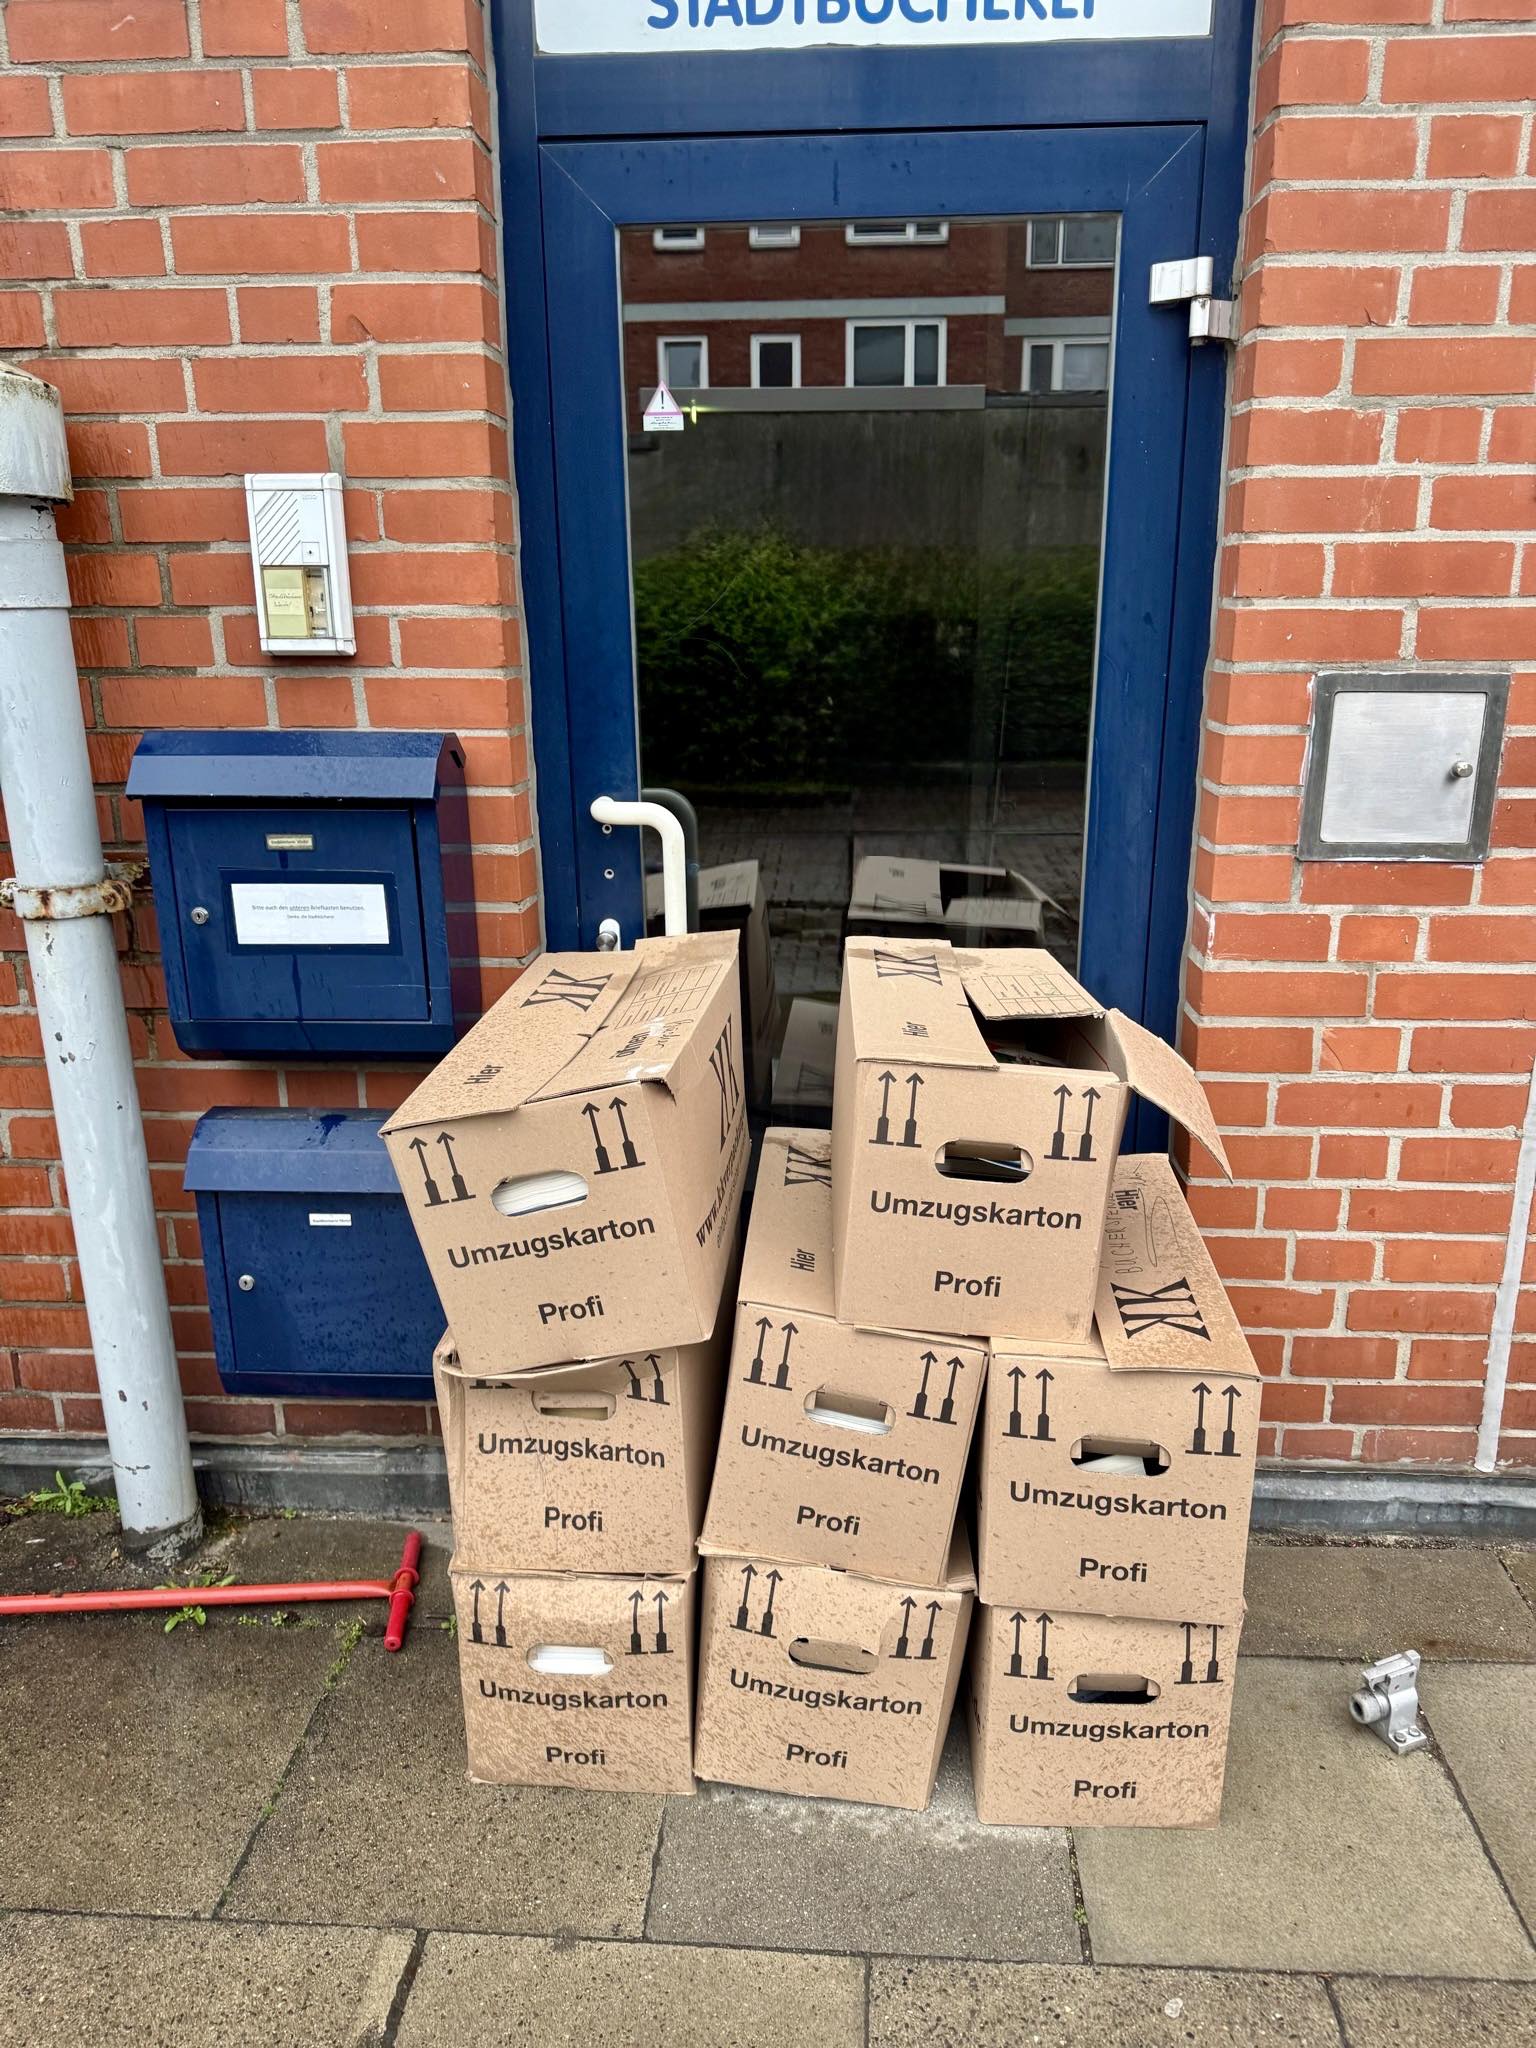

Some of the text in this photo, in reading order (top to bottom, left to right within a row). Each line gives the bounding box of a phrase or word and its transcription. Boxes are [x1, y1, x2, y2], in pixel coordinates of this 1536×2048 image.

[902, 1021, 929, 1038] Hier
[463, 1064, 505, 1085] Hier
[871, 1190, 1082, 1230] Umzugskarton
[1114, 1188, 1140, 1211] Hier
[447, 1214, 656, 1269] Umzugskarton
[790, 1248, 816, 1272] Hier
[934, 1270, 1001, 1297] Profi
[538, 1295, 604, 1325] Profi
[478, 1433, 665, 1468] Umzugskarton
[741, 1425, 940, 1485] Umzugskarton
[1010, 1480, 1228, 1521] Umzugskarton
[544, 1506, 603, 1532] Profi
[796, 1505, 860, 1535] Profi
[1080, 1557, 1147, 1583] Profi
[479, 1679, 668, 1711] Umzugskarton
[729, 1667, 923, 1715] Umzugskarton
[1010, 1714, 1209, 1743] Umzugskarton
[546, 1746, 606, 1765] Profi
[786, 1743, 847, 1768] Profi
[1074, 1780, 1136, 1799] Profi
